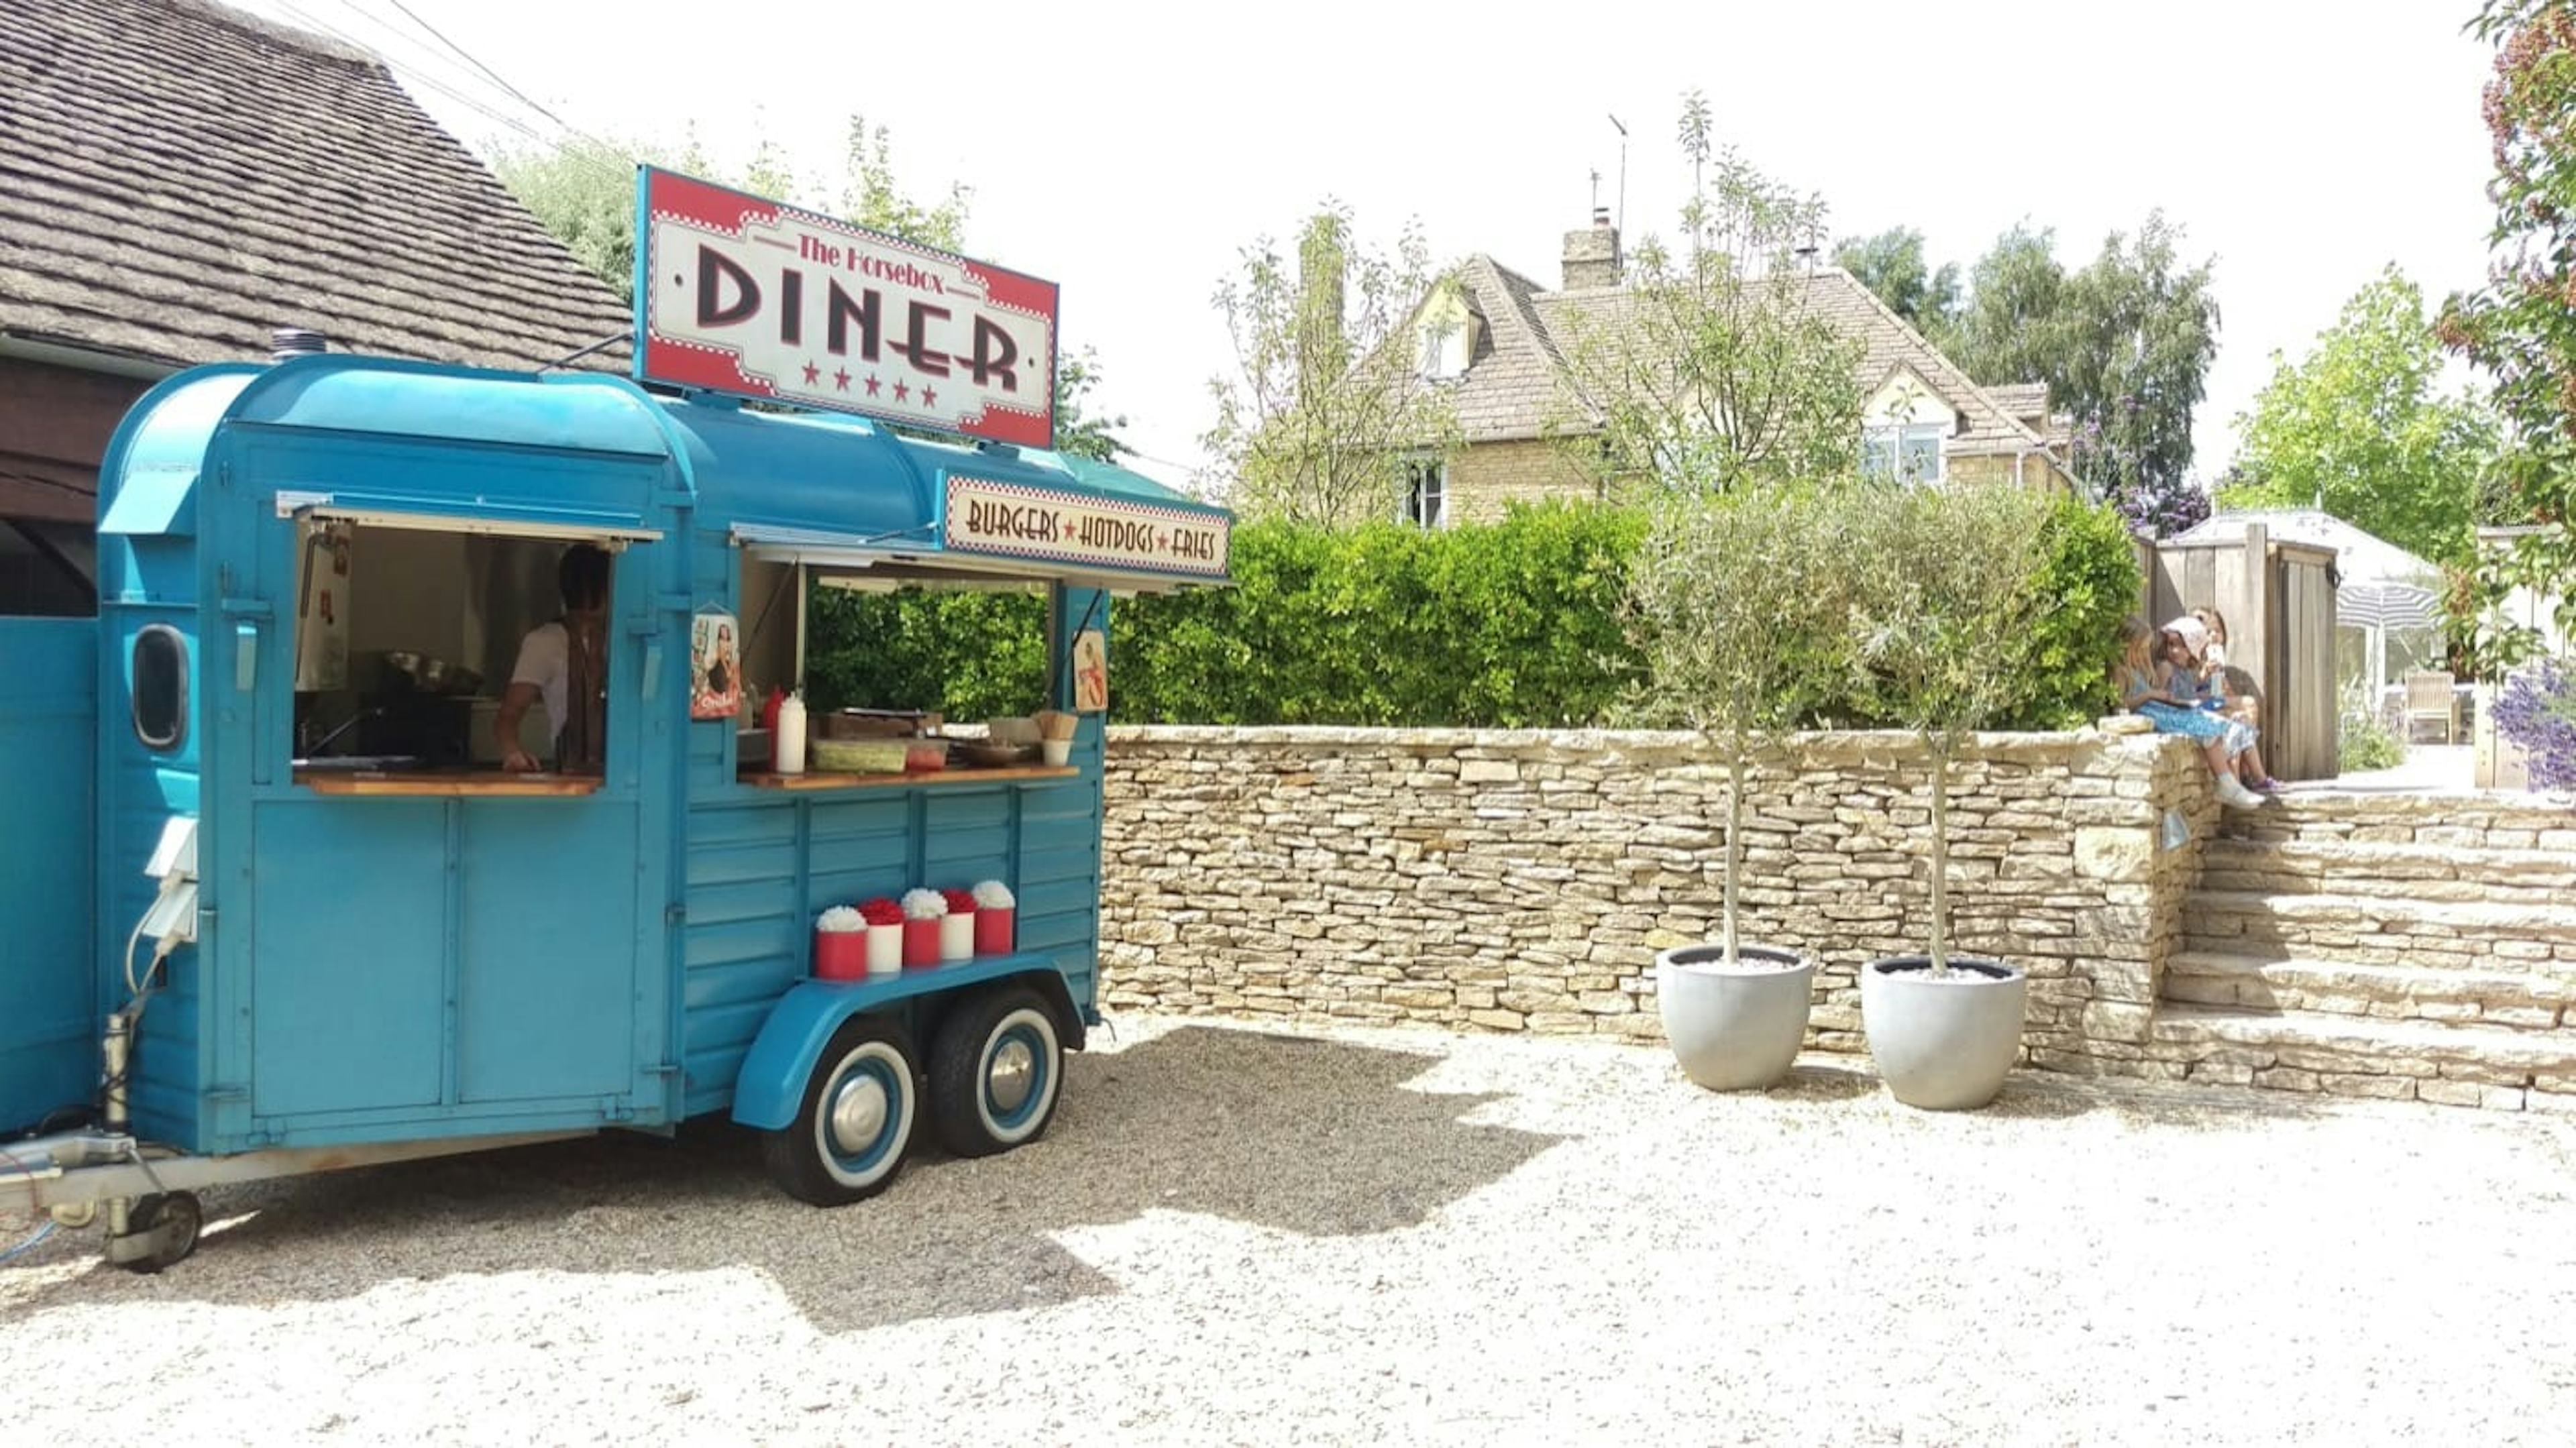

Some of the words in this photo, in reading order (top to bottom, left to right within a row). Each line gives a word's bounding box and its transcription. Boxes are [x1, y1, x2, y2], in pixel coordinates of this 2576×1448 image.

[800, 233, 841, 264] The
[846, 247, 944, 295] Horsebox
[697, 243, 1018, 392] DINER
[966, 499, 1059, 543] BURGERS
[1079, 515, 1154, 553] HOTDOGS
[1171, 528, 1215, 560] FRIES
